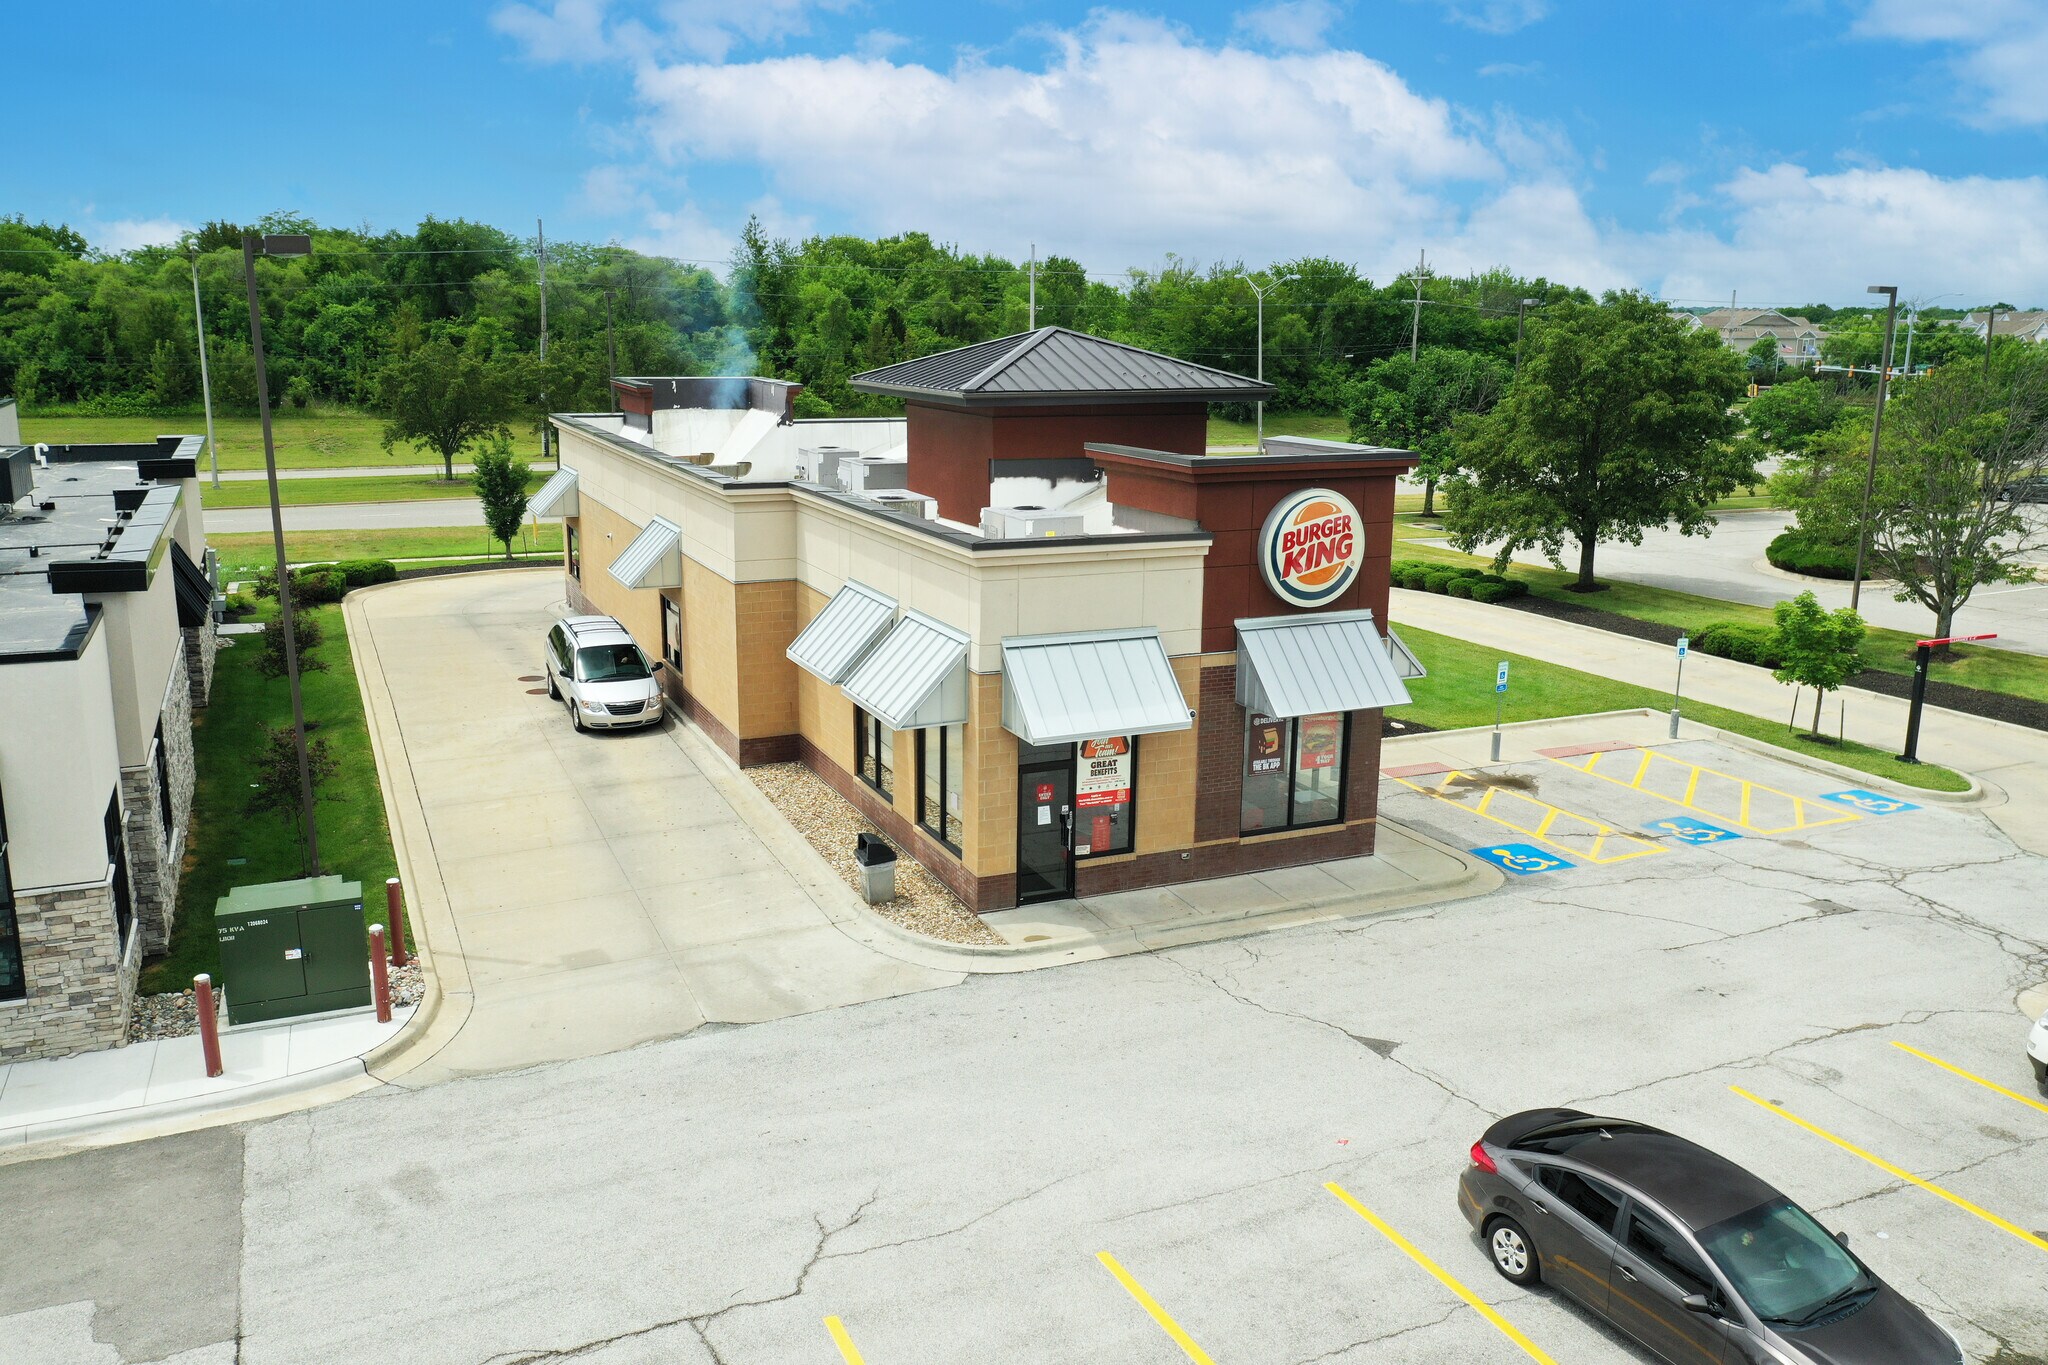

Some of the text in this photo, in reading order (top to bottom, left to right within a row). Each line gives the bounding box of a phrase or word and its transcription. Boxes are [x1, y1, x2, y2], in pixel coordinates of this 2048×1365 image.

[1282, 515, 1351, 553] BURGER
[1282, 533, 1353, 579] KING
[1095, 745, 1119, 758] Team!
[1090, 759, 1118, 769] GREAT
[1090, 767, 1118, 777] BENEFITS
[229, 925, 245, 933] KVA
